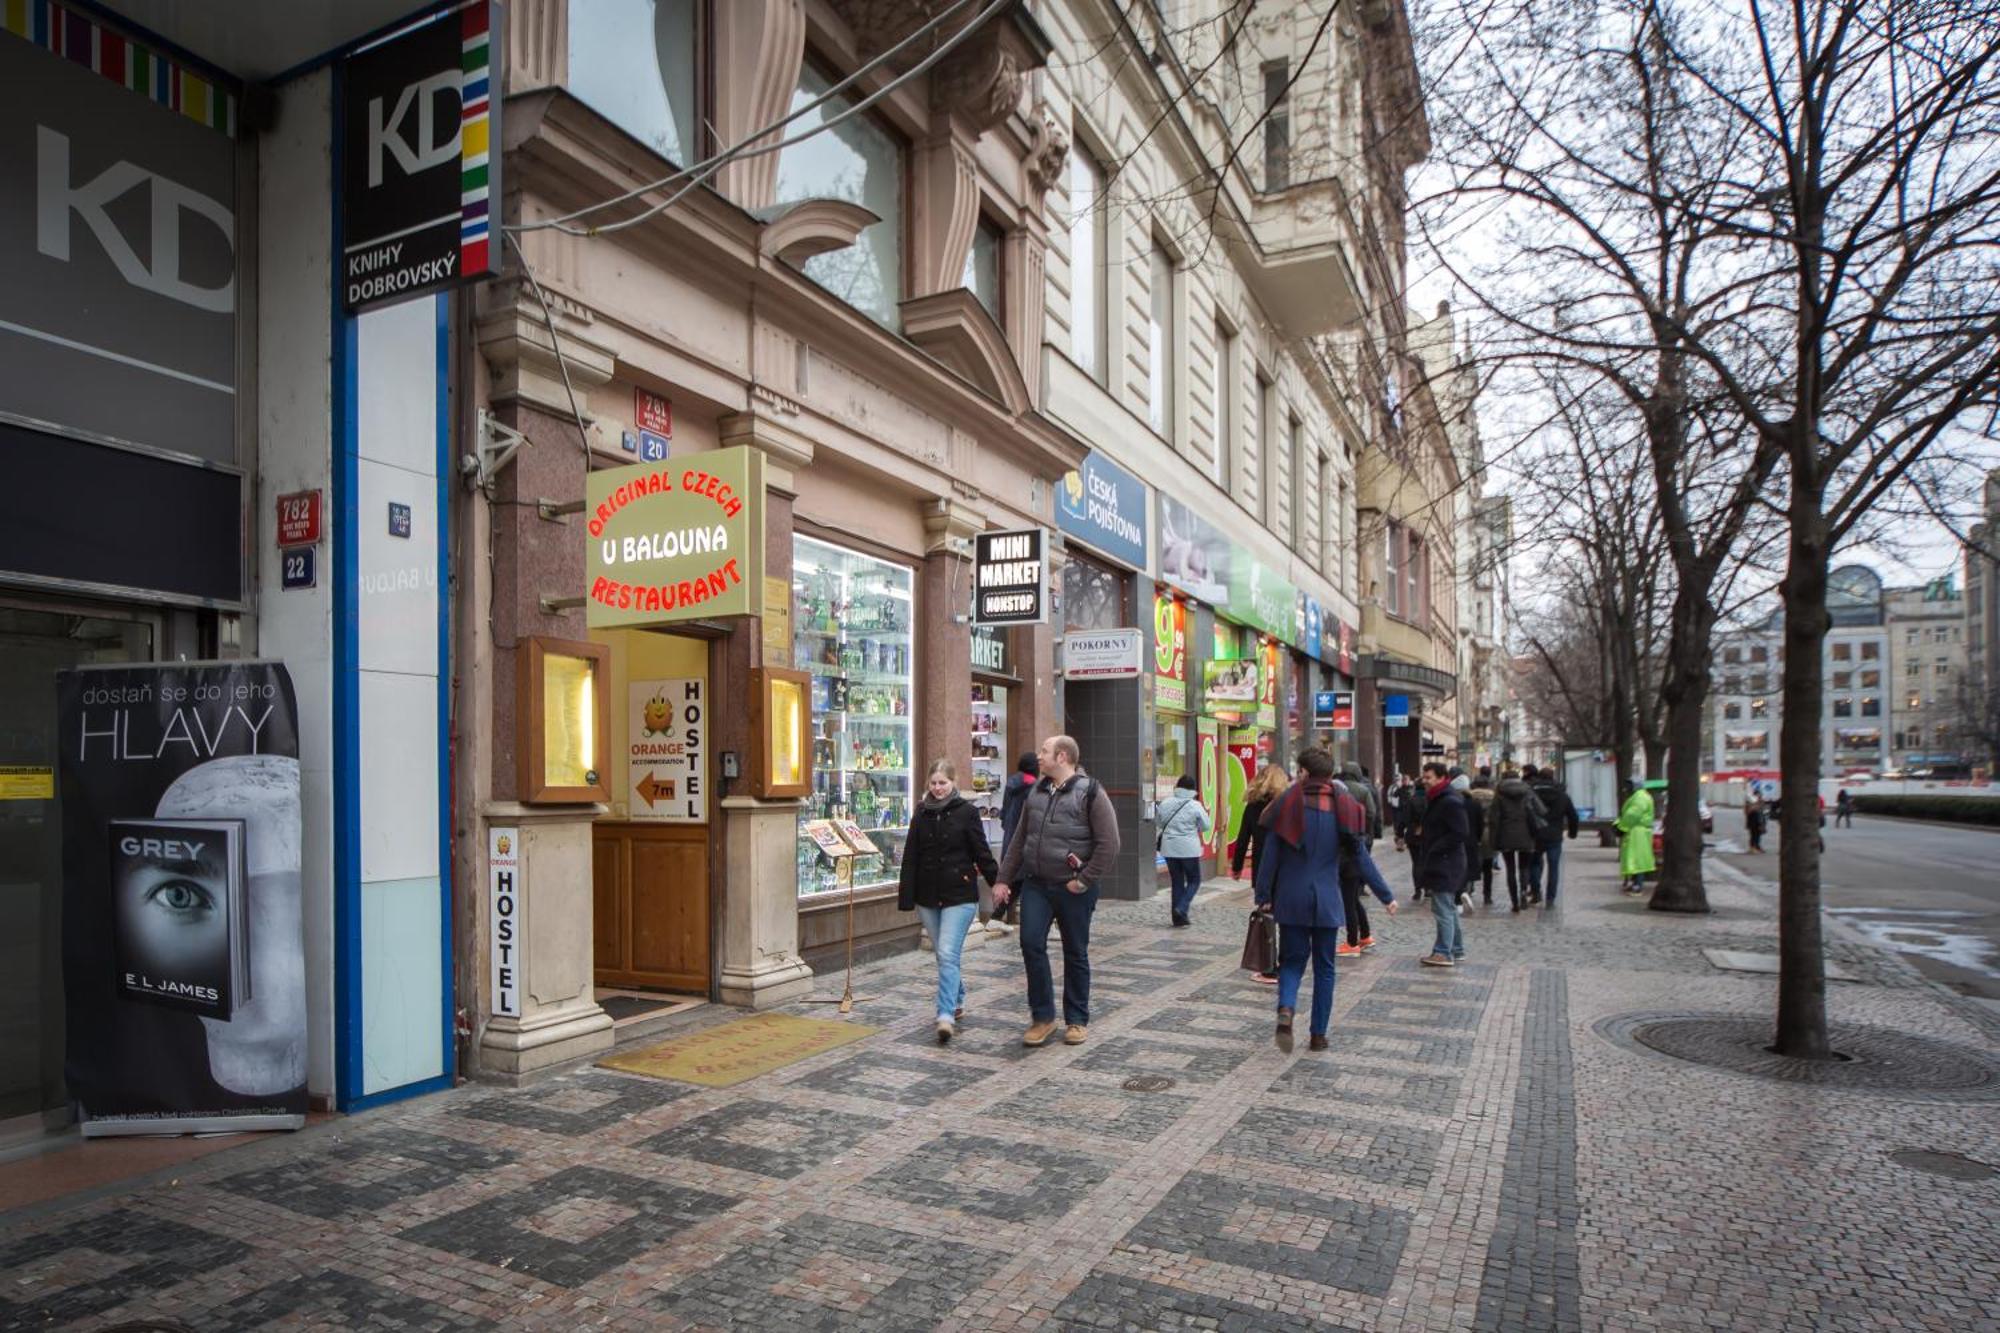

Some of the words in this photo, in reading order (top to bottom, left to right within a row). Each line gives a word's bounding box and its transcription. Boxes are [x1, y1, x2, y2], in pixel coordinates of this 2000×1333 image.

[367, 68, 463, 189] KD
[36, 122, 235, 314] KD
[349, 242, 404, 277] KNIHY
[349, 250, 456, 304] DOBROVSKÝ
[648, 439, 663, 460] 20
[1088, 467, 1118, 507] ČESKÁ
[283, 498, 310, 522] 782
[588, 471, 672, 538] ORIGINAL
[681, 469, 743, 519] CZECH
[602, 540, 617, 565] U
[623, 524, 728, 563] BALOUNA
[990, 535, 1031, 561] MINI
[287, 557, 305, 579] 22
[979, 560, 1041, 587] MARKET
[591, 557, 742, 612] RESTAURANT
[986, 594, 1034, 613] NONSTOP
[83, 684, 152, 704] dostaň
[160, 687, 187, 702] se
[194, 682, 221, 700] do
[229, 682, 275, 703] jeho
[80, 704, 275, 762] HLAVY
[631, 743, 684, 755] ORANGE
[684, 681, 700, 818] HOSTEL
[652, 784, 673, 797] 7m
[120, 836, 205, 862] GREY
[496, 871, 514, 1013] HOSTEL
[125, 973, 136, 985] E
[142, 976, 152, 988] L
[157, 980, 218, 1001] JAMES
